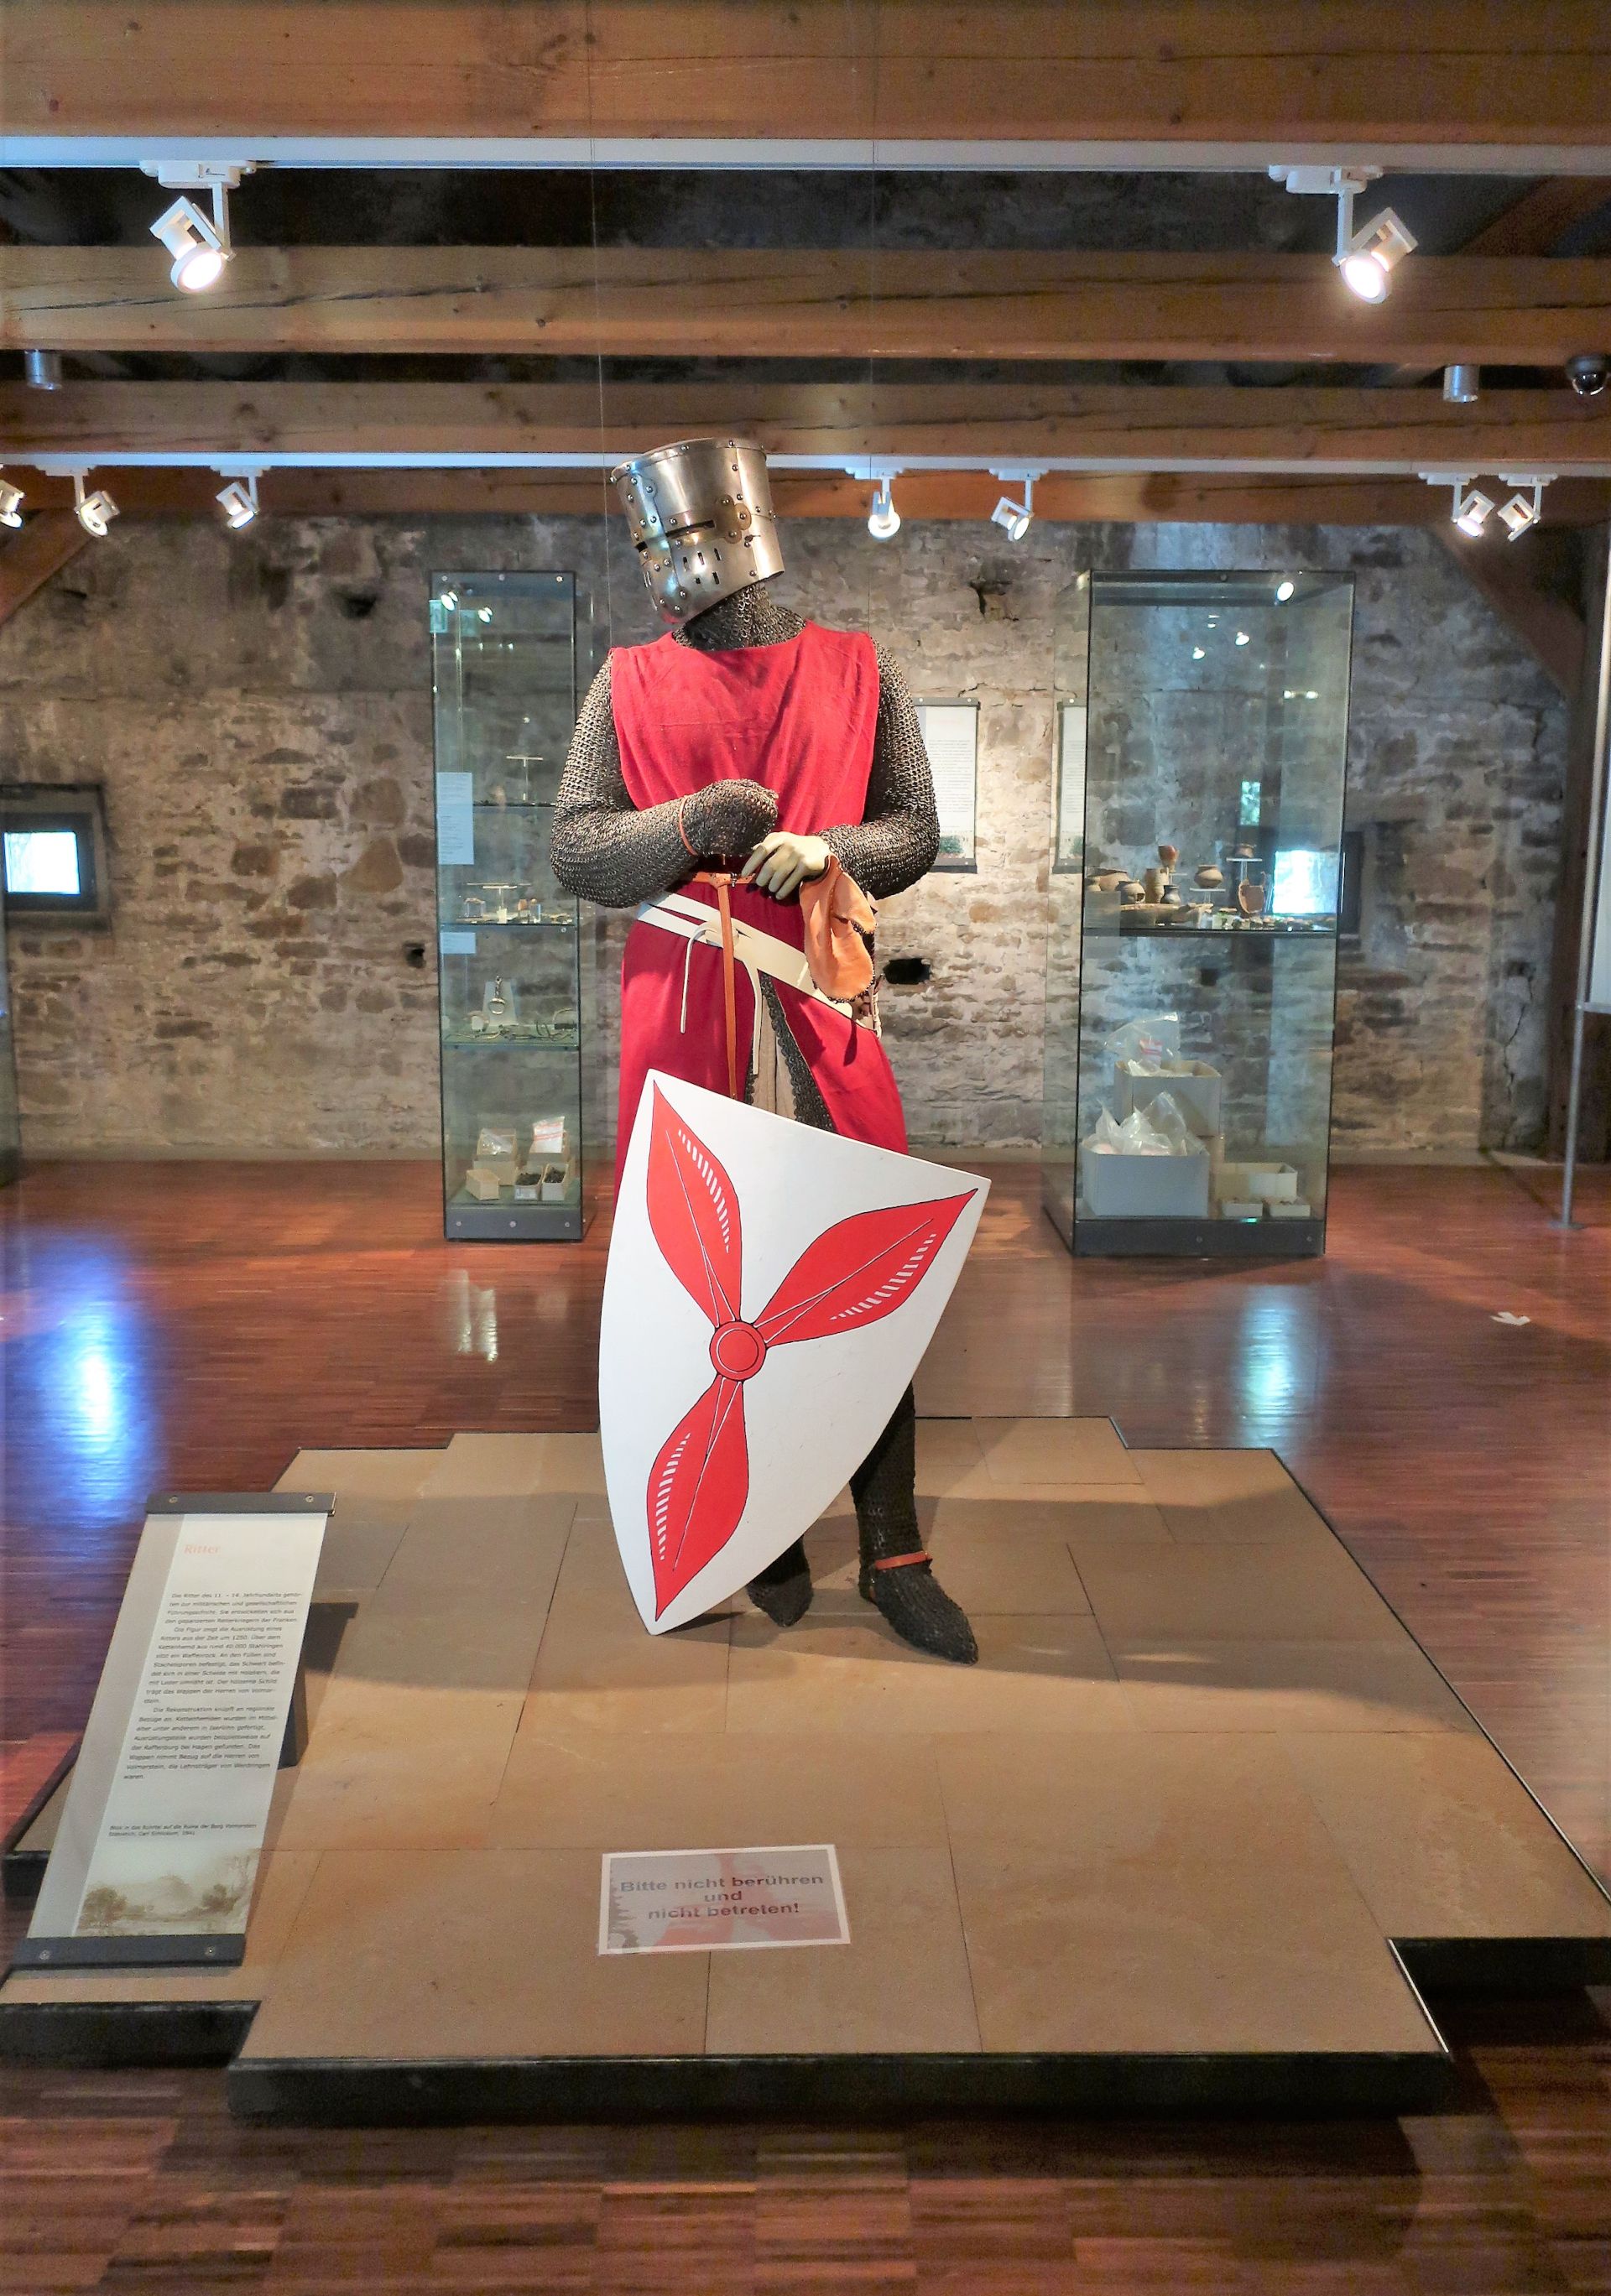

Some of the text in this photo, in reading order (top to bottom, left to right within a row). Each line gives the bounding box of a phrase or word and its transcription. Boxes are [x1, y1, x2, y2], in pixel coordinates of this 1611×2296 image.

[184, 1544, 220, 1554] Ritter
[620, 1874, 824, 1893] Bitte nicht berühren
[704, 1891, 743, 1902] und
[649, 1903, 800, 1920] nicht betreten!
